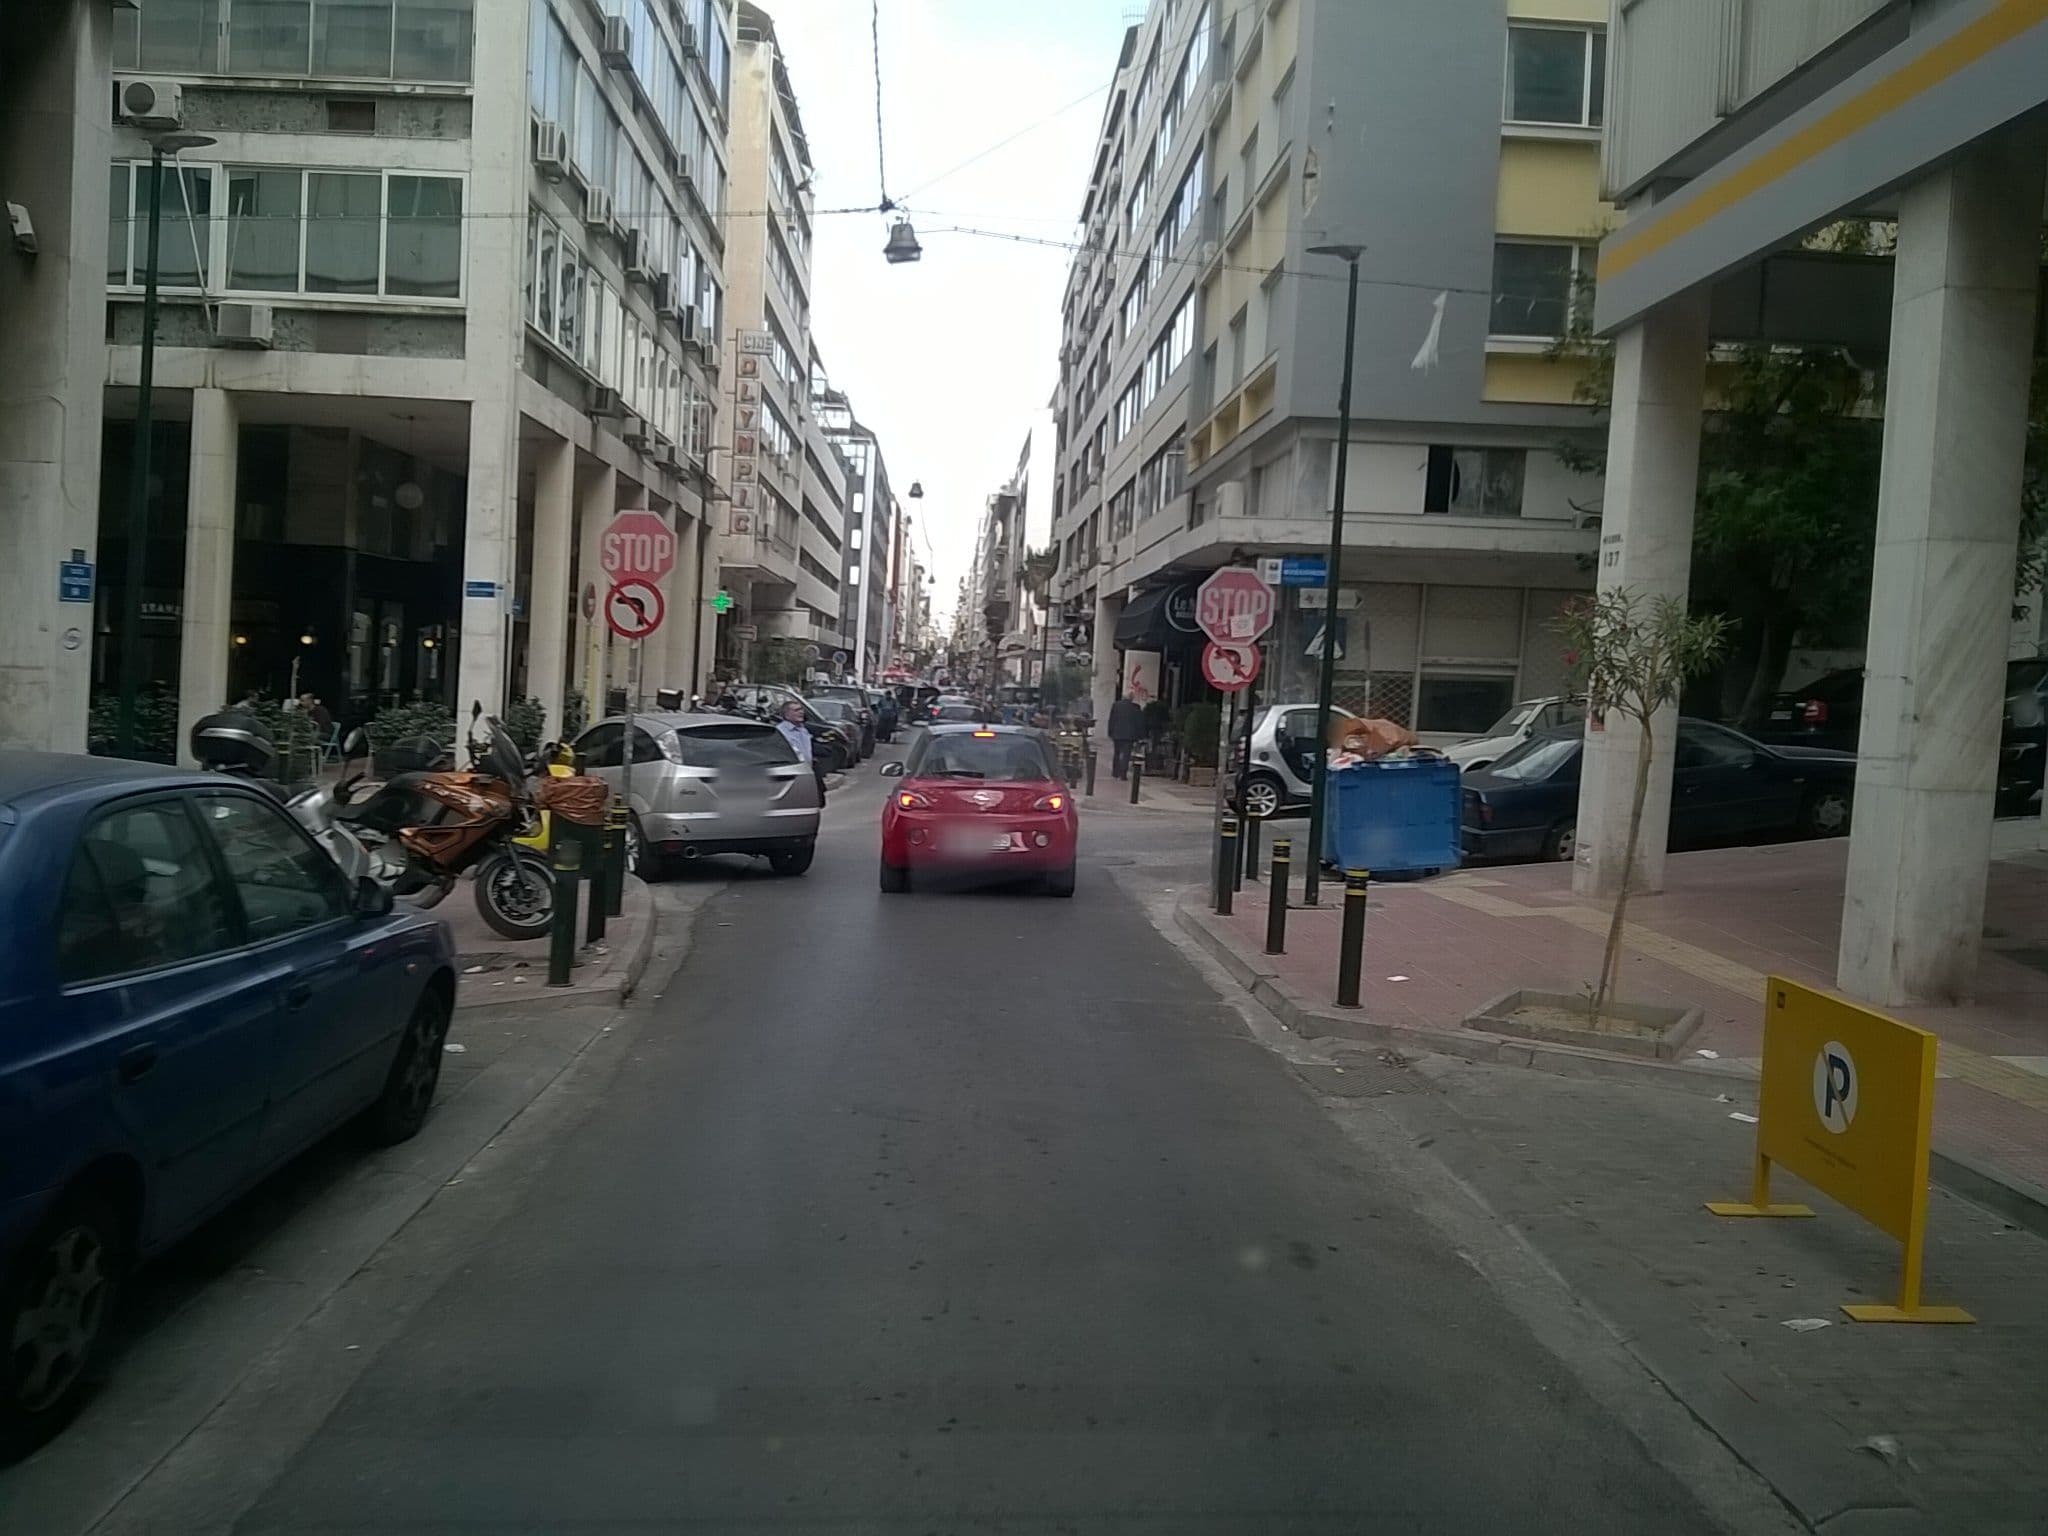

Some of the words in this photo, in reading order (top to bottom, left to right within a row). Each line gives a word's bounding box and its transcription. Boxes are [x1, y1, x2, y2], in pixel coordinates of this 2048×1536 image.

[744, 335, 773, 349] CINE
[734, 358, 756, 532] OLYMPIC
[603, 532, 672, 573] STOP
[1604, 550, 1621, 569] 137
[1202, 587, 1266, 625] STOP
